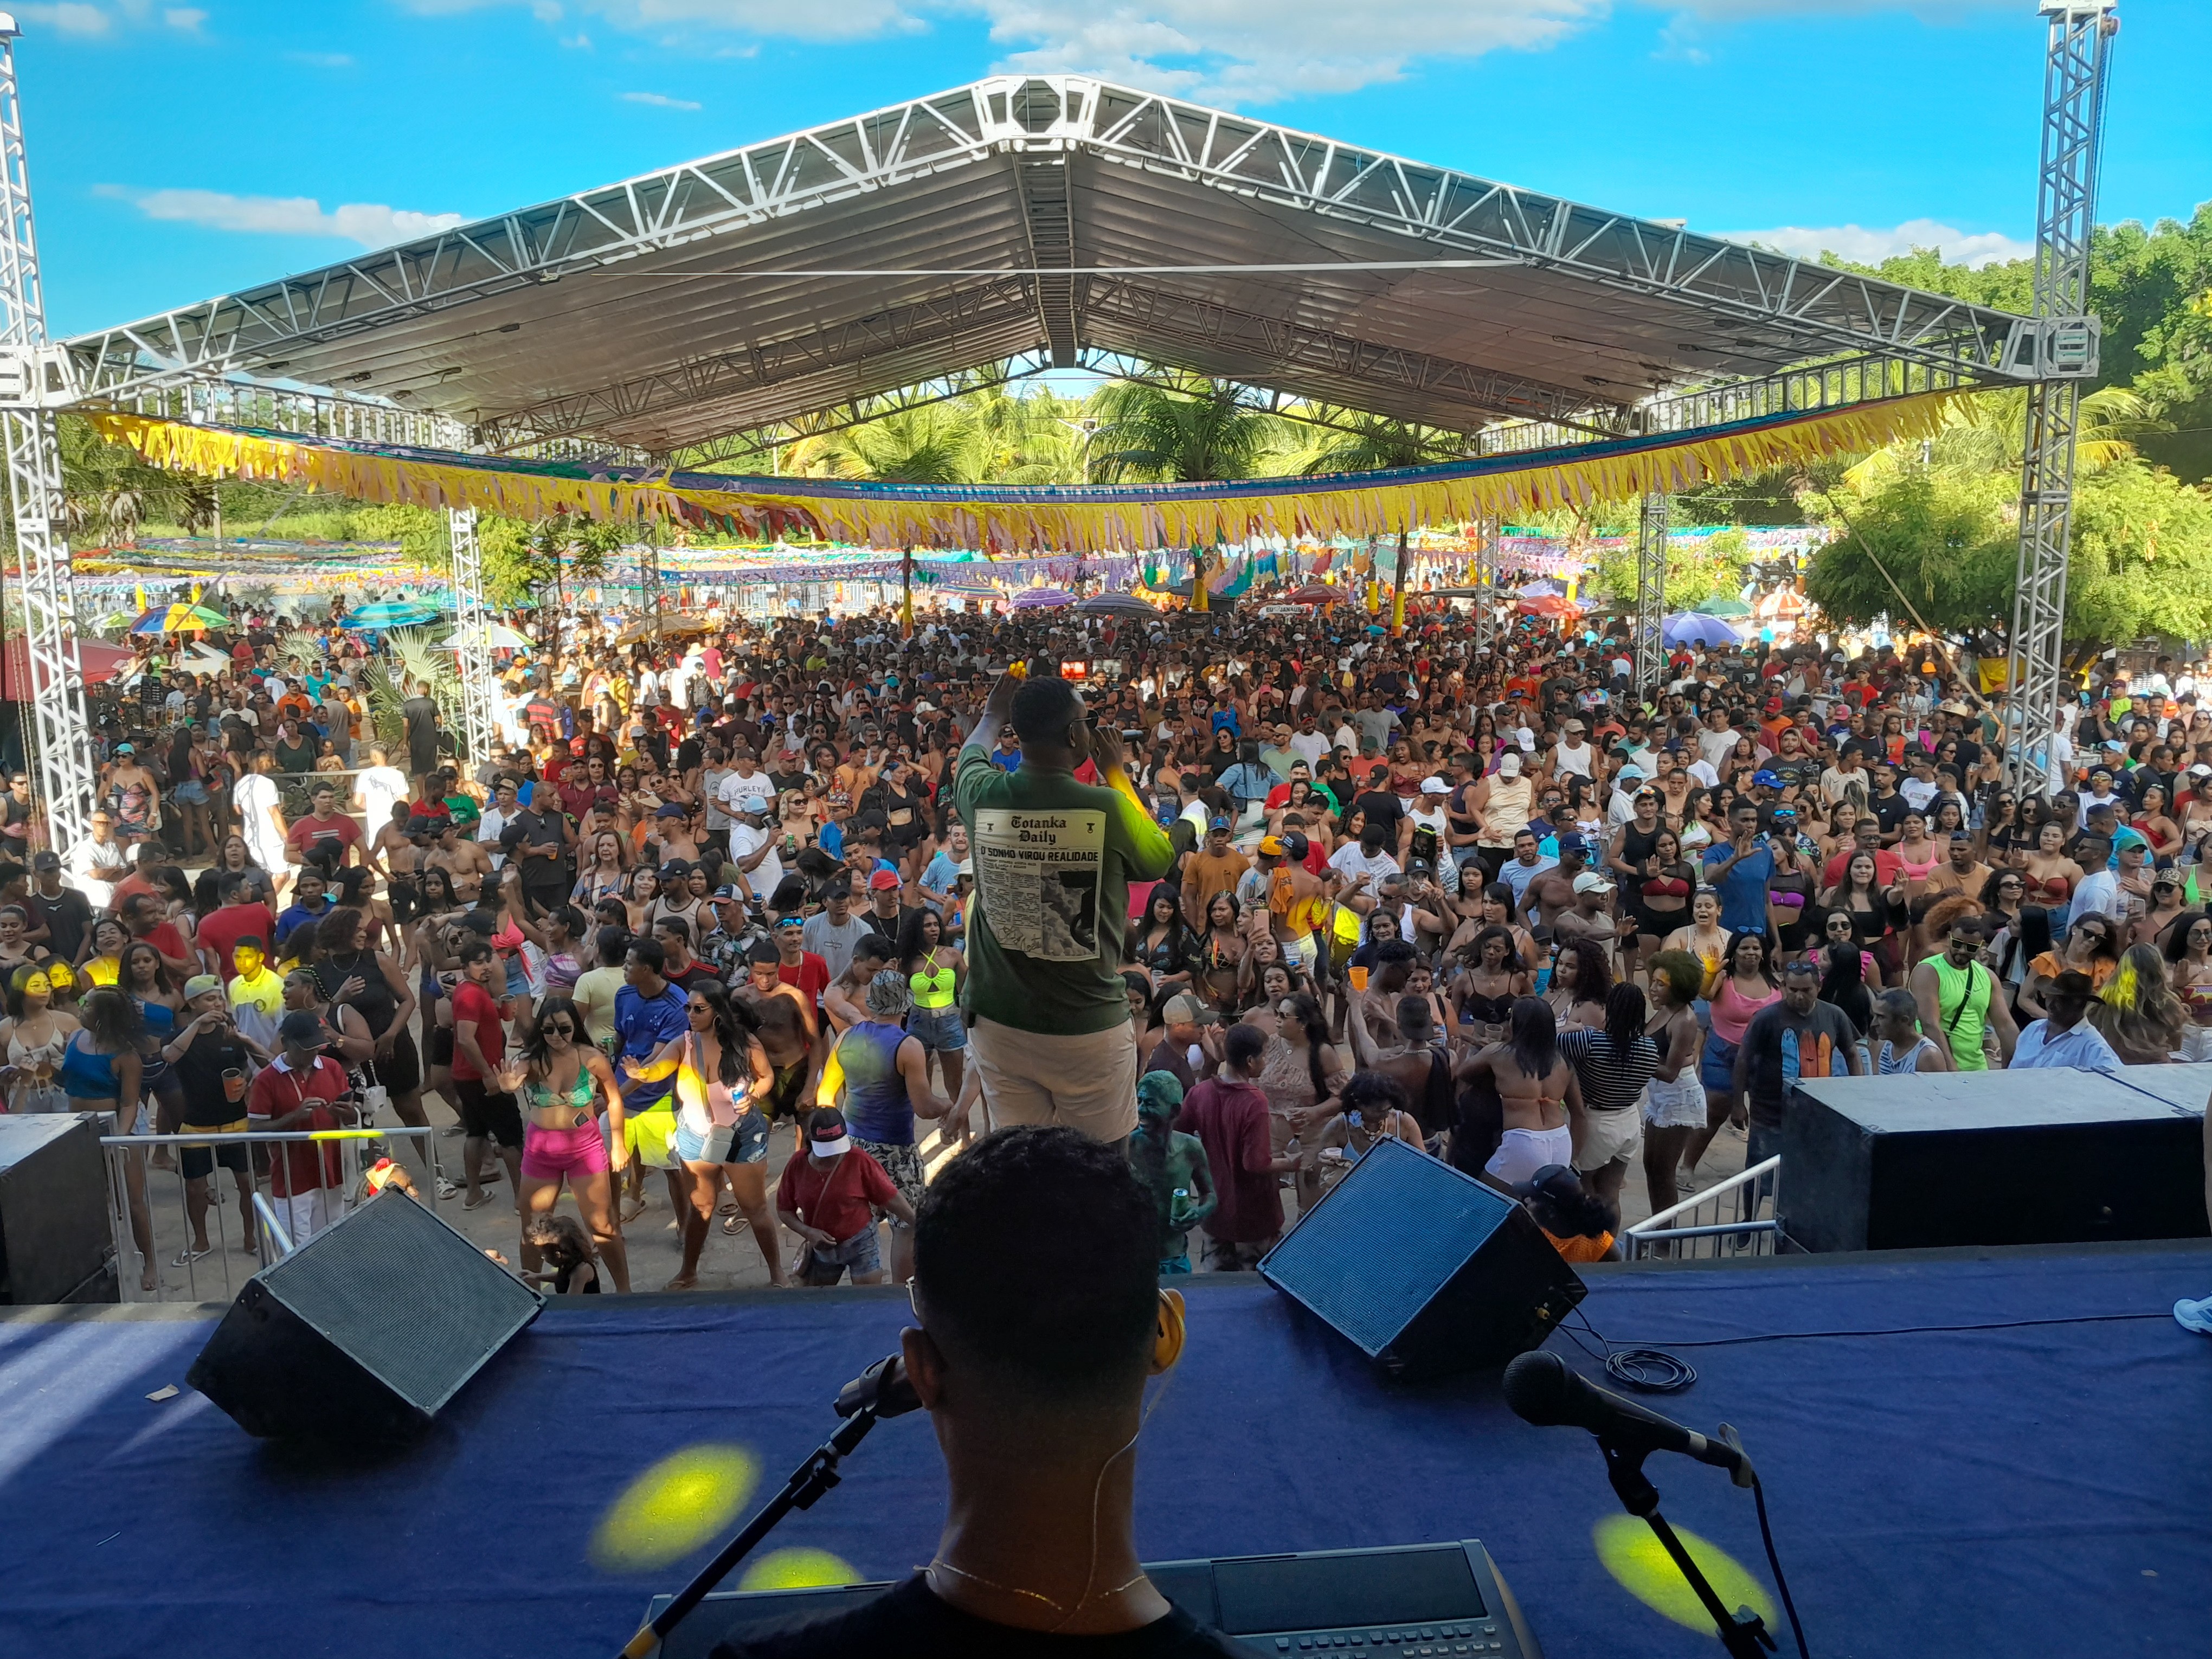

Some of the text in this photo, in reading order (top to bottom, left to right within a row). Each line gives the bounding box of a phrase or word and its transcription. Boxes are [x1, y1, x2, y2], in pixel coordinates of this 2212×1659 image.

[734, 786, 761, 796] HURLEY
[1011, 815, 1066, 828] Totanka
[1019, 830, 1056, 845] Daily
[981, 846, 1098, 861] O SONHO VIROU REALIDADE
